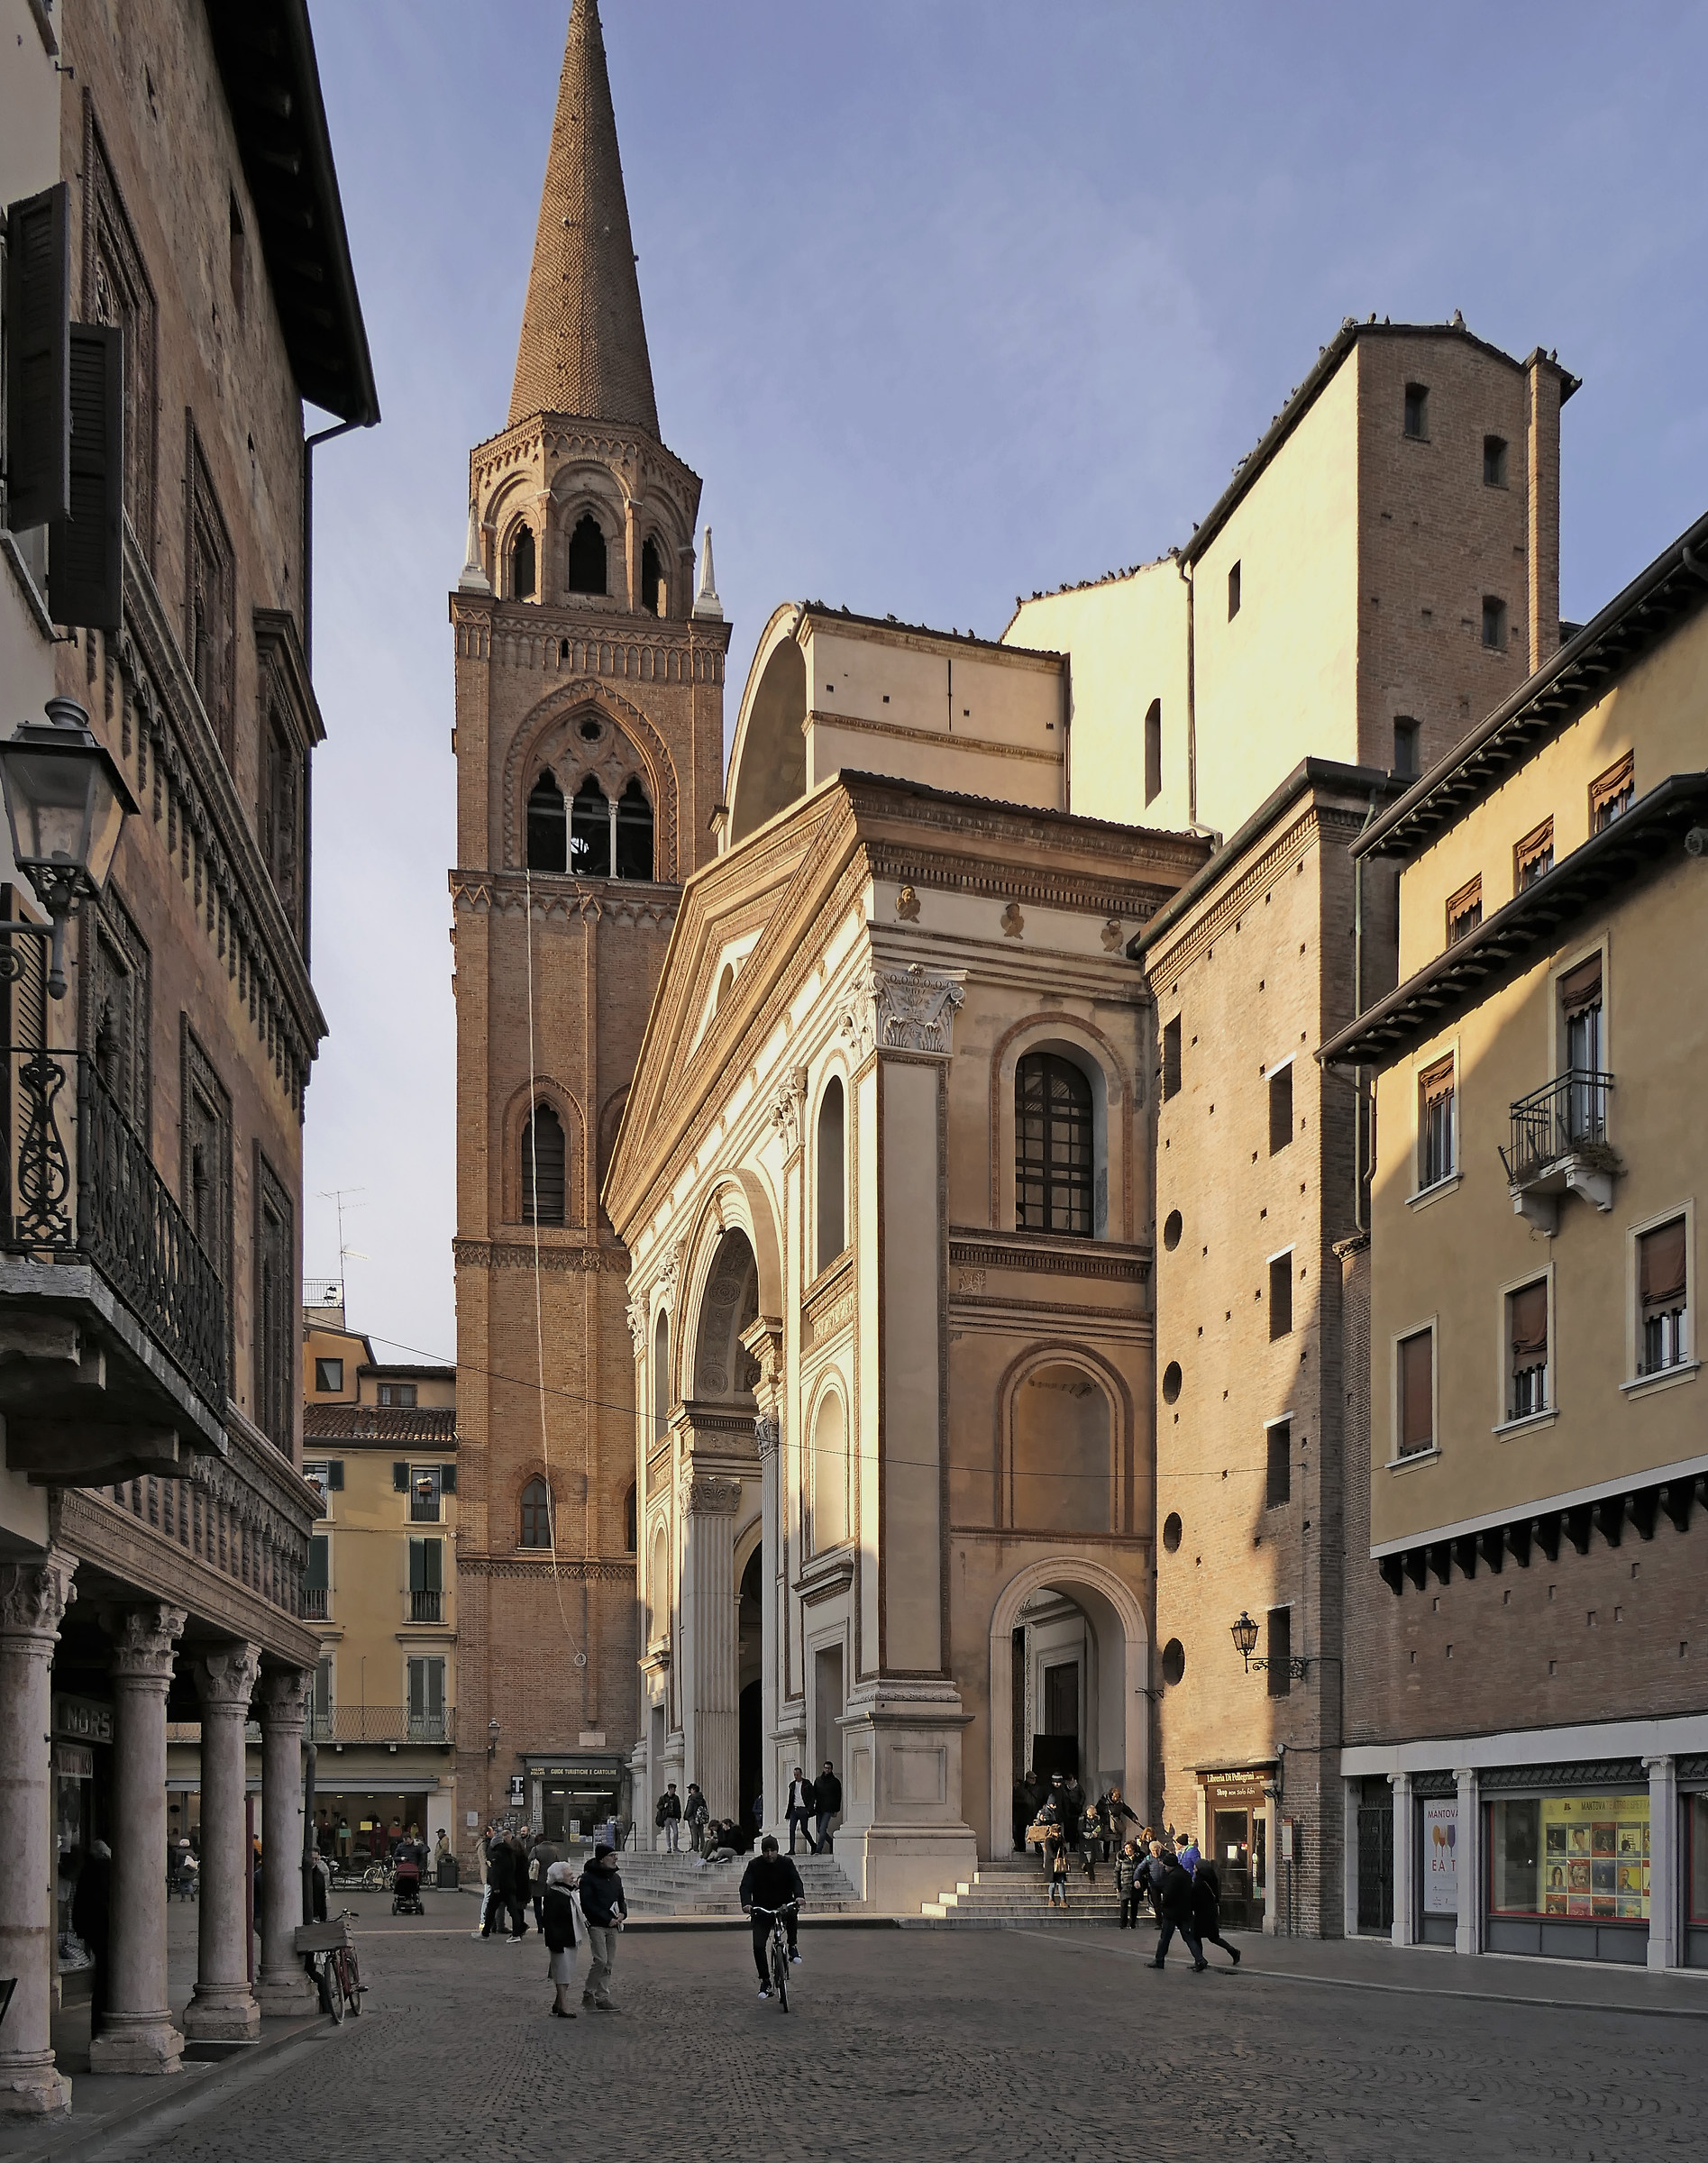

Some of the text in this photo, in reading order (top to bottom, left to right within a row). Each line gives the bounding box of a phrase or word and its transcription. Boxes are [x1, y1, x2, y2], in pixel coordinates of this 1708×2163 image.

[1207, 1774, 1225, 1783] Libreria
[1225, 1773, 1232, 1782] Di
[1232, 1772, 1255, 1783] Pellegrini
[512, 1776, 524, 1793] T
[1581, 1801, 1605, 1811] MANTOVA
